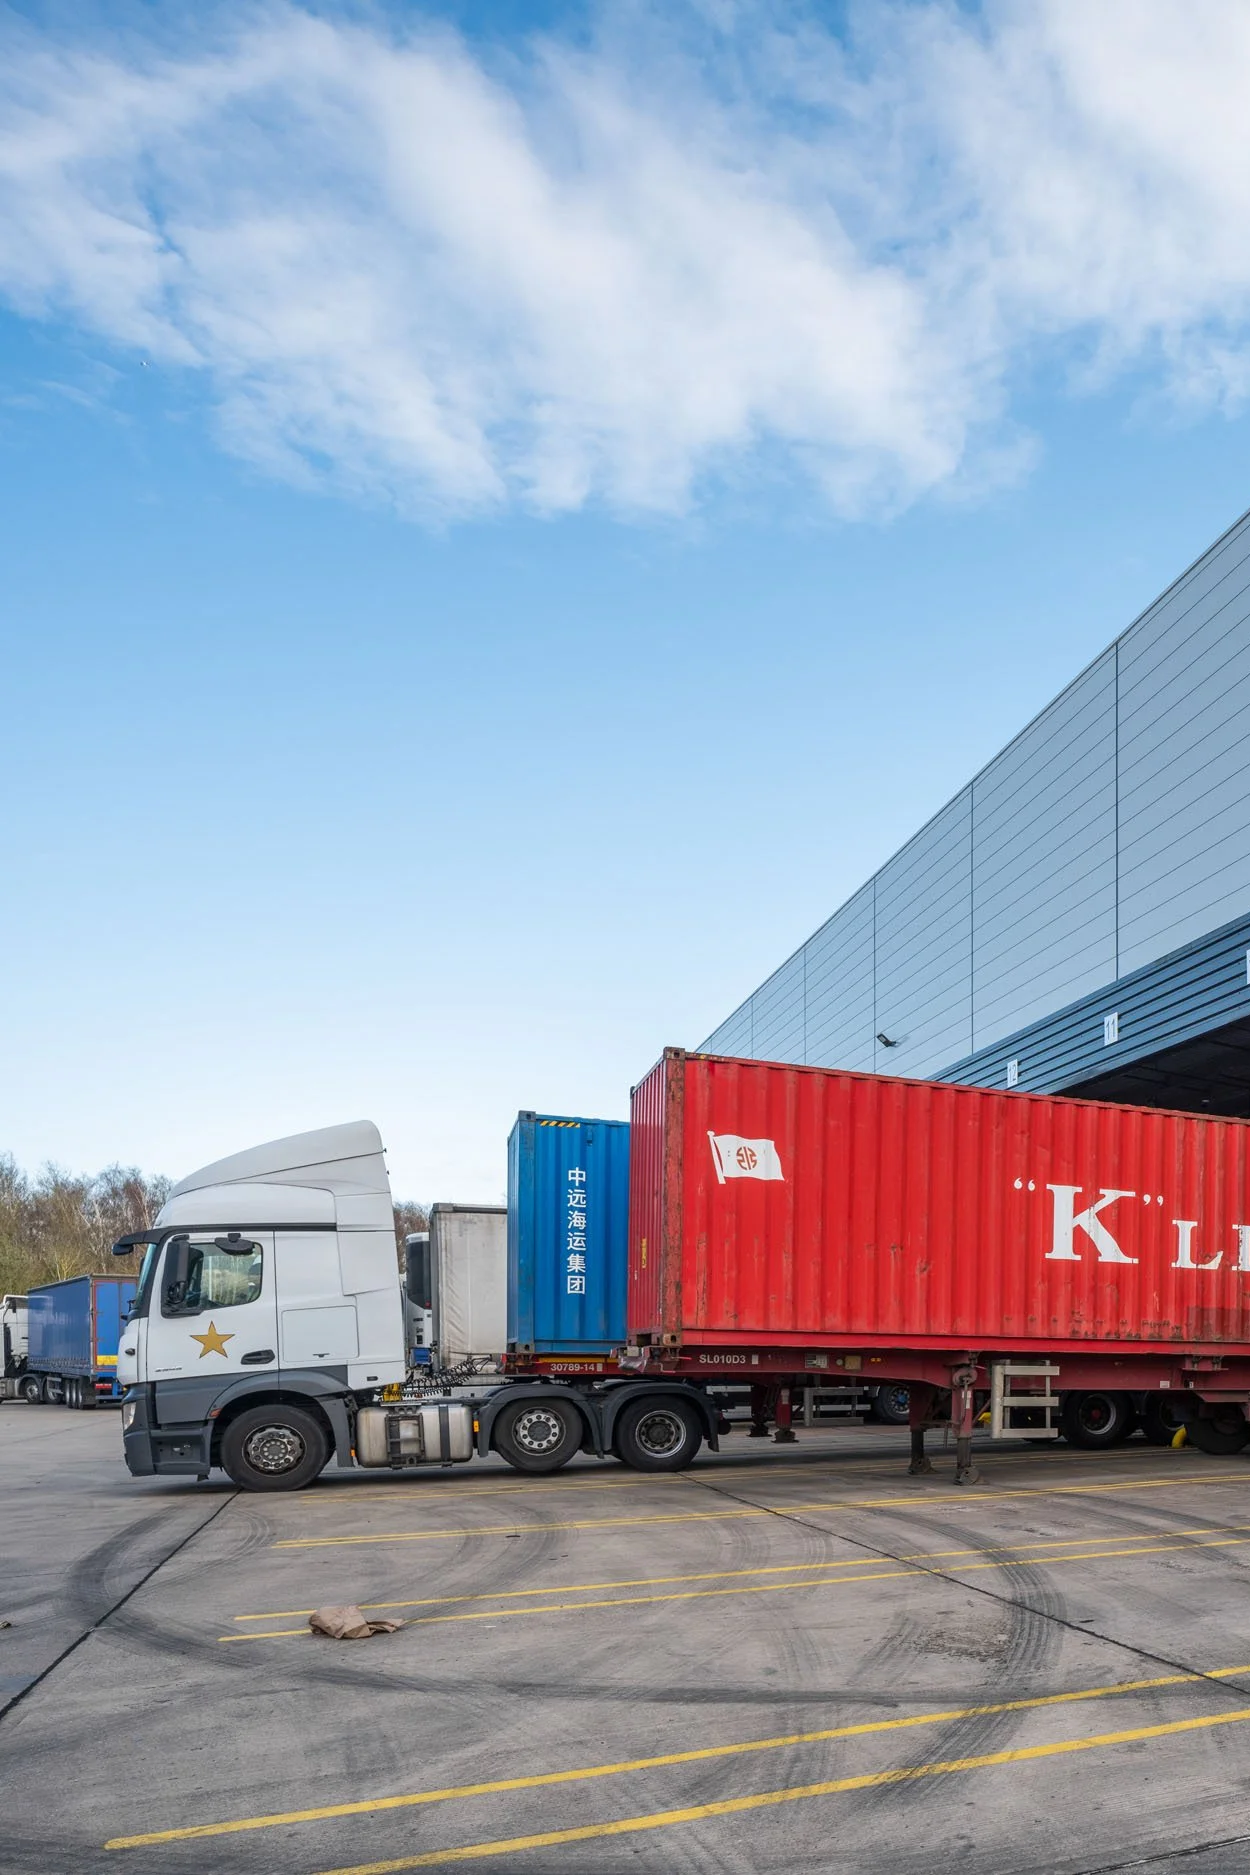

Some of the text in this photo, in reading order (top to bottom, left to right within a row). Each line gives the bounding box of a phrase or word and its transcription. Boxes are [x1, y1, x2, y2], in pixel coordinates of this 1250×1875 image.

[1105, 1018, 1115, 1041] 11
[1008, 1063, 1017, 1082] 12
[566, 1166, 587, 1295] 中远海运集团
[550, 1363, 595, 1372] 30789-14
[699, 1354, 746, 1364] SL010D3
